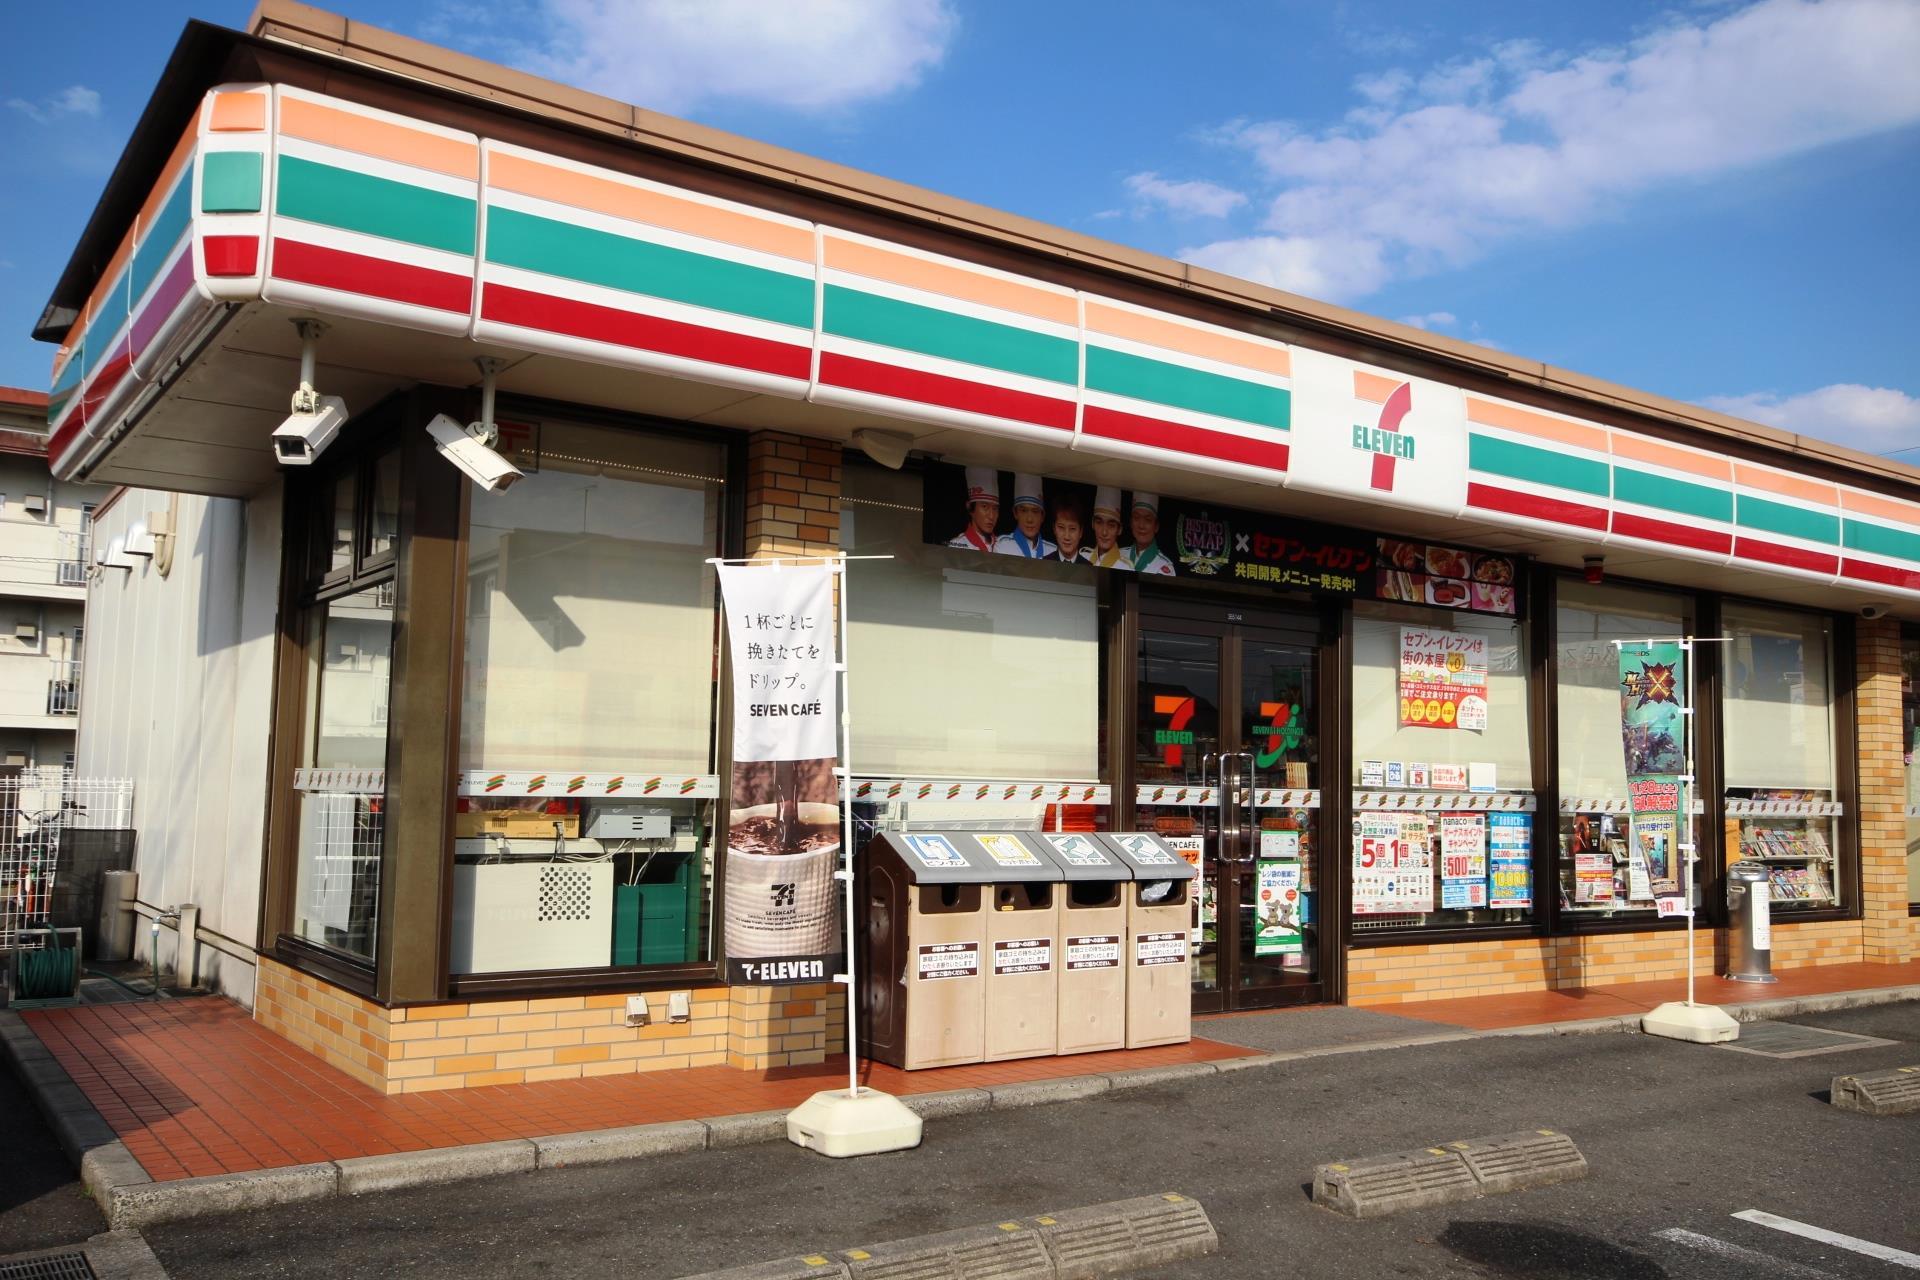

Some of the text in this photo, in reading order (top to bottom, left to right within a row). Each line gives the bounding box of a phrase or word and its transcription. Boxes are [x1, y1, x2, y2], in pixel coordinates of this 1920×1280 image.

[1185, 518, 1223, 536] BISTRO
[1185, 532, 1224, 551] SMAP
[745, 613, 814, 630] 1杯ごとに
[747, 642, 820, 660] 挽きたてを
[1402, 650, 1446, 669] 街の本屋
[750, 673, 807, 690] ドリップ。
[750, 698, 822, 717] SEVEN CAFÉ
[1443, 818, 1467, 826] nanaco
[1179, 839, 1196, 849] CAFÉ
[1448, 839, 1478, 848] キャンペーン
[1262, 870, 1295, 879] レジ袋の削減に
[1447, 856, 1468, 877] 500
[1261, 879, 1298, 888] ご協力ください。
